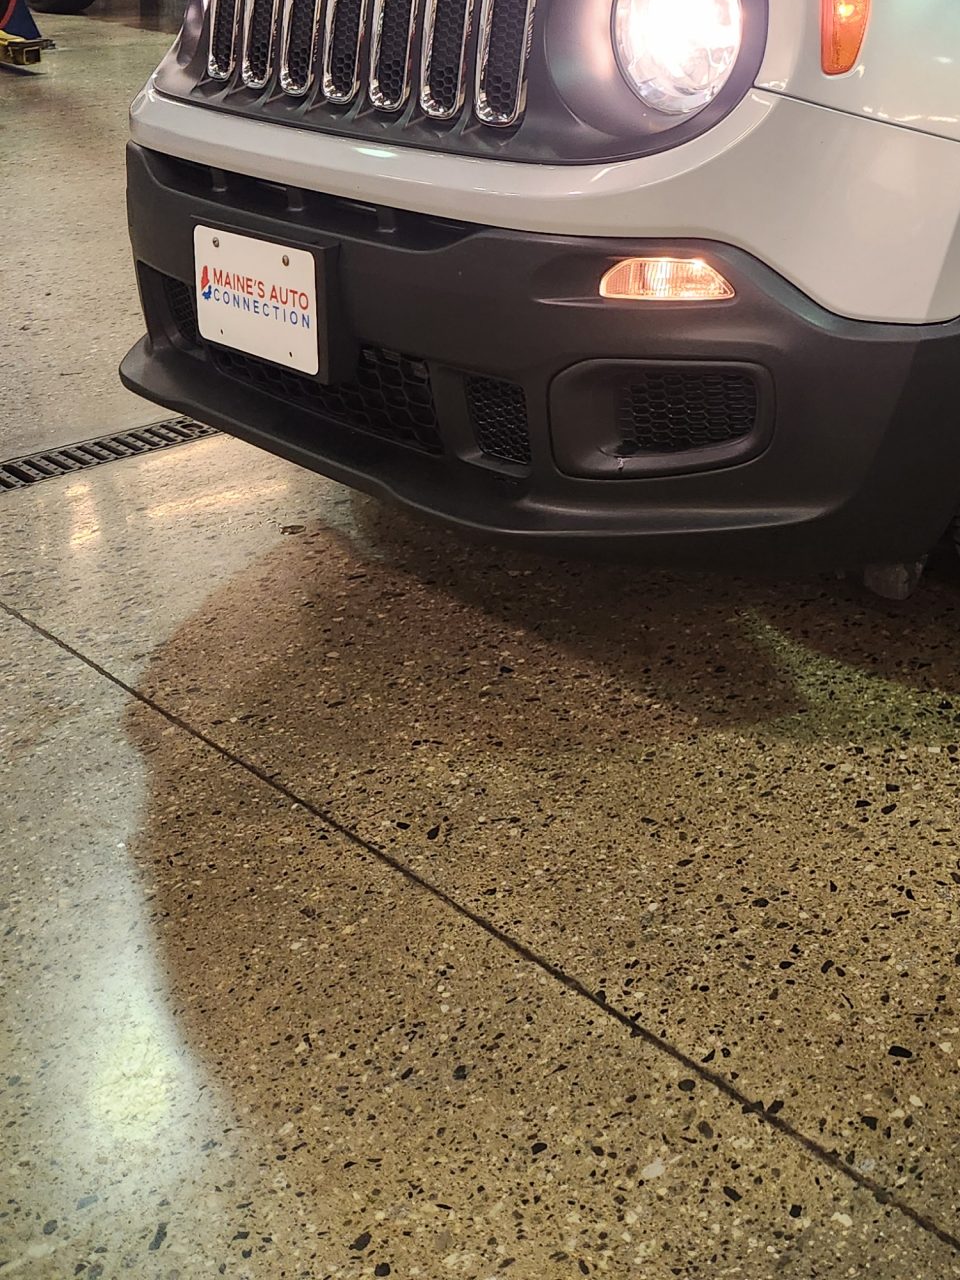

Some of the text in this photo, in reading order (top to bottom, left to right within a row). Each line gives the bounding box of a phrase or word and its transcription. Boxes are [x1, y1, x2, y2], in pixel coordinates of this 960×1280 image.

[213, 268, 309, 311] MAINE'S AUTO
[213, 288, 310, 329] CONNECTION
